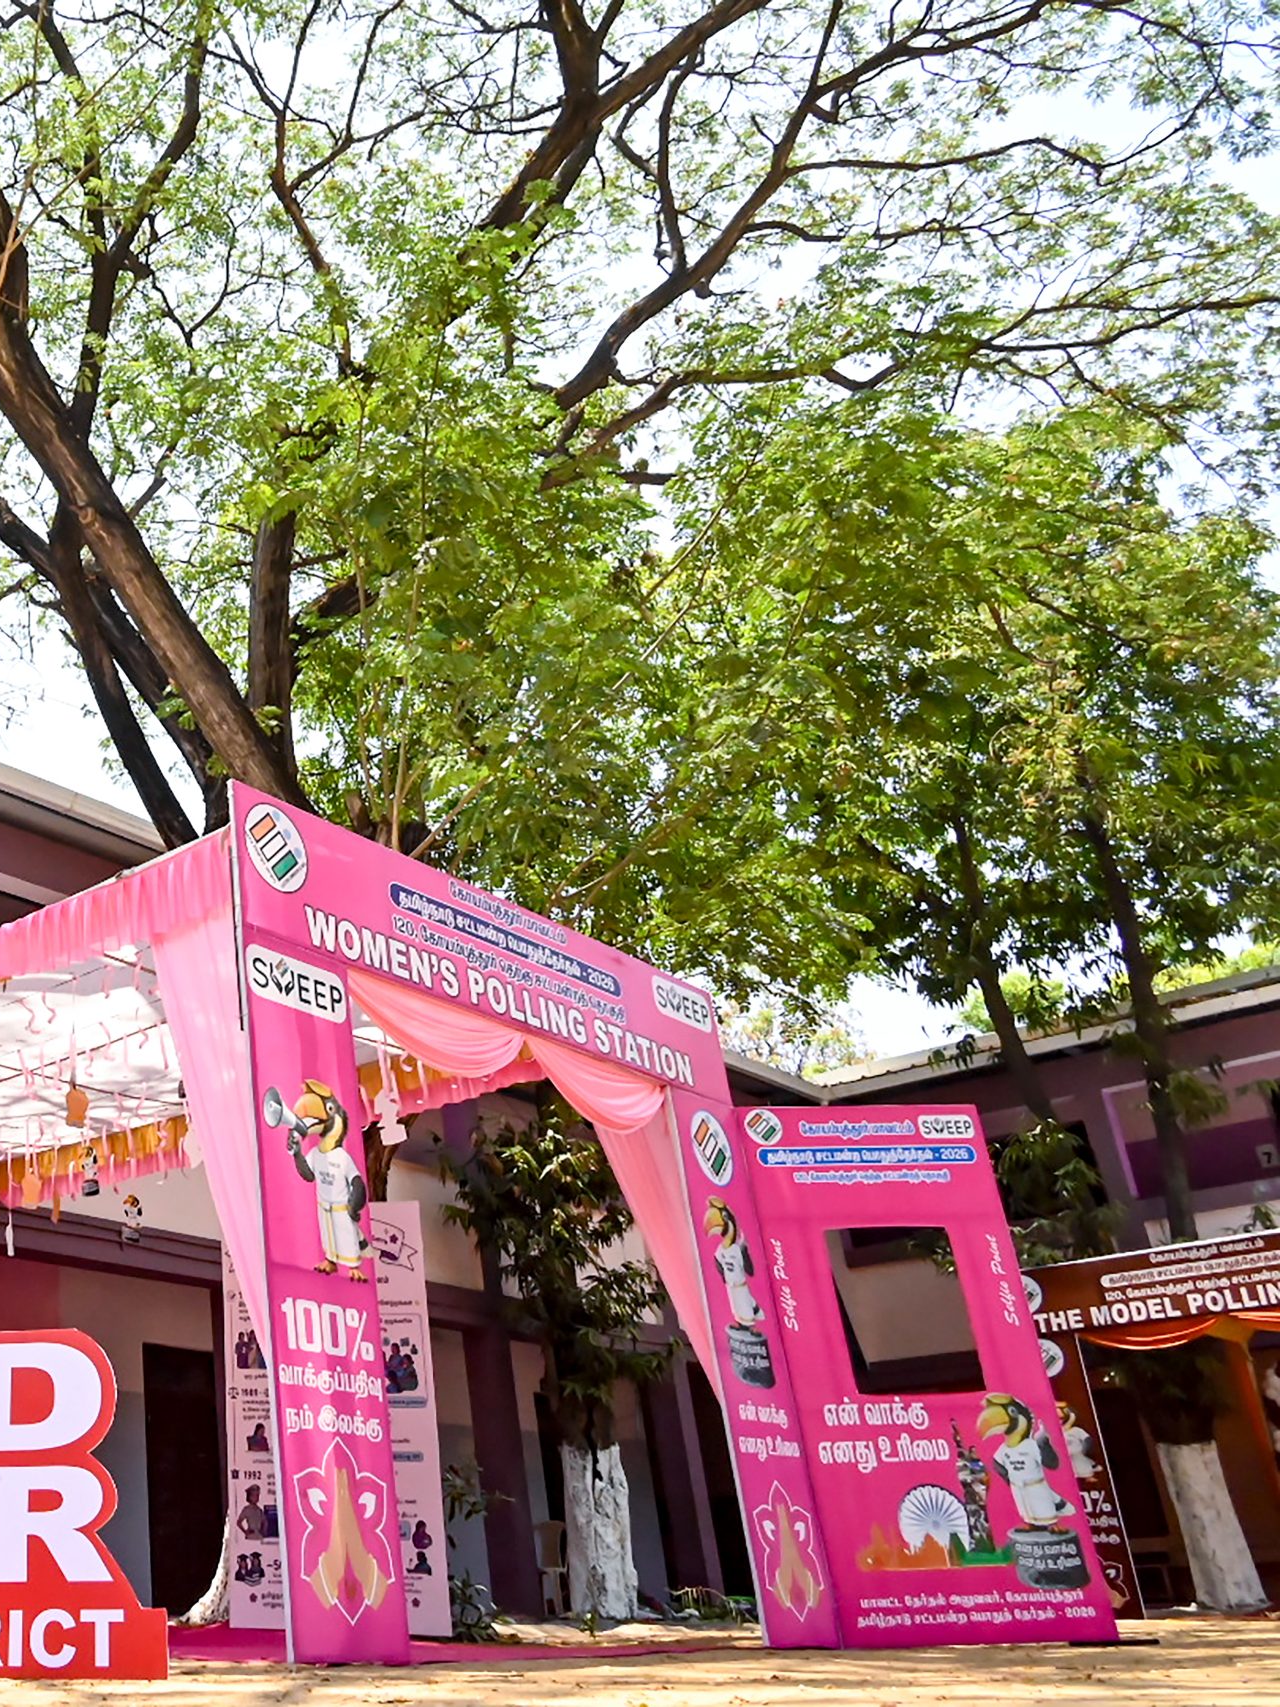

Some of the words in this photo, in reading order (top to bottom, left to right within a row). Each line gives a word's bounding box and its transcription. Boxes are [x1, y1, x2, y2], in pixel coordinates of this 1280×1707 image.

[253, 957, 342, 1013] SWEEP
[304, 905, 460, 999] WOMEN'S
[467, 968, 587, 1045] POLLING
[594, 1018, 695, 1088] STATION
[587, 968, 615, 991] 2026
[656, 985, 708, 1025] SWEEP
[922, 1119, 971, 1135] SWEEP
[940, 1148, 968, 1160] 2026
[281, 1297, 375, 1361] 100%
[1033, 1308, 1085, 1333] THE
[1090, 1295, 1183, 1327] MODEL
[279, 1362, 383, 1402] வாக்குப்பதிவு
[286, 1404, 314, 1435] நம்
[318, 1404, 383, 1442] இலக்கு
[824, 1396, 860, 1426] என்
[864, 1396, 929, 1430] வாக்கு
[818, 1440, 878, 1473] எனது
[878, 1433, 950, 1462] உரிமை
